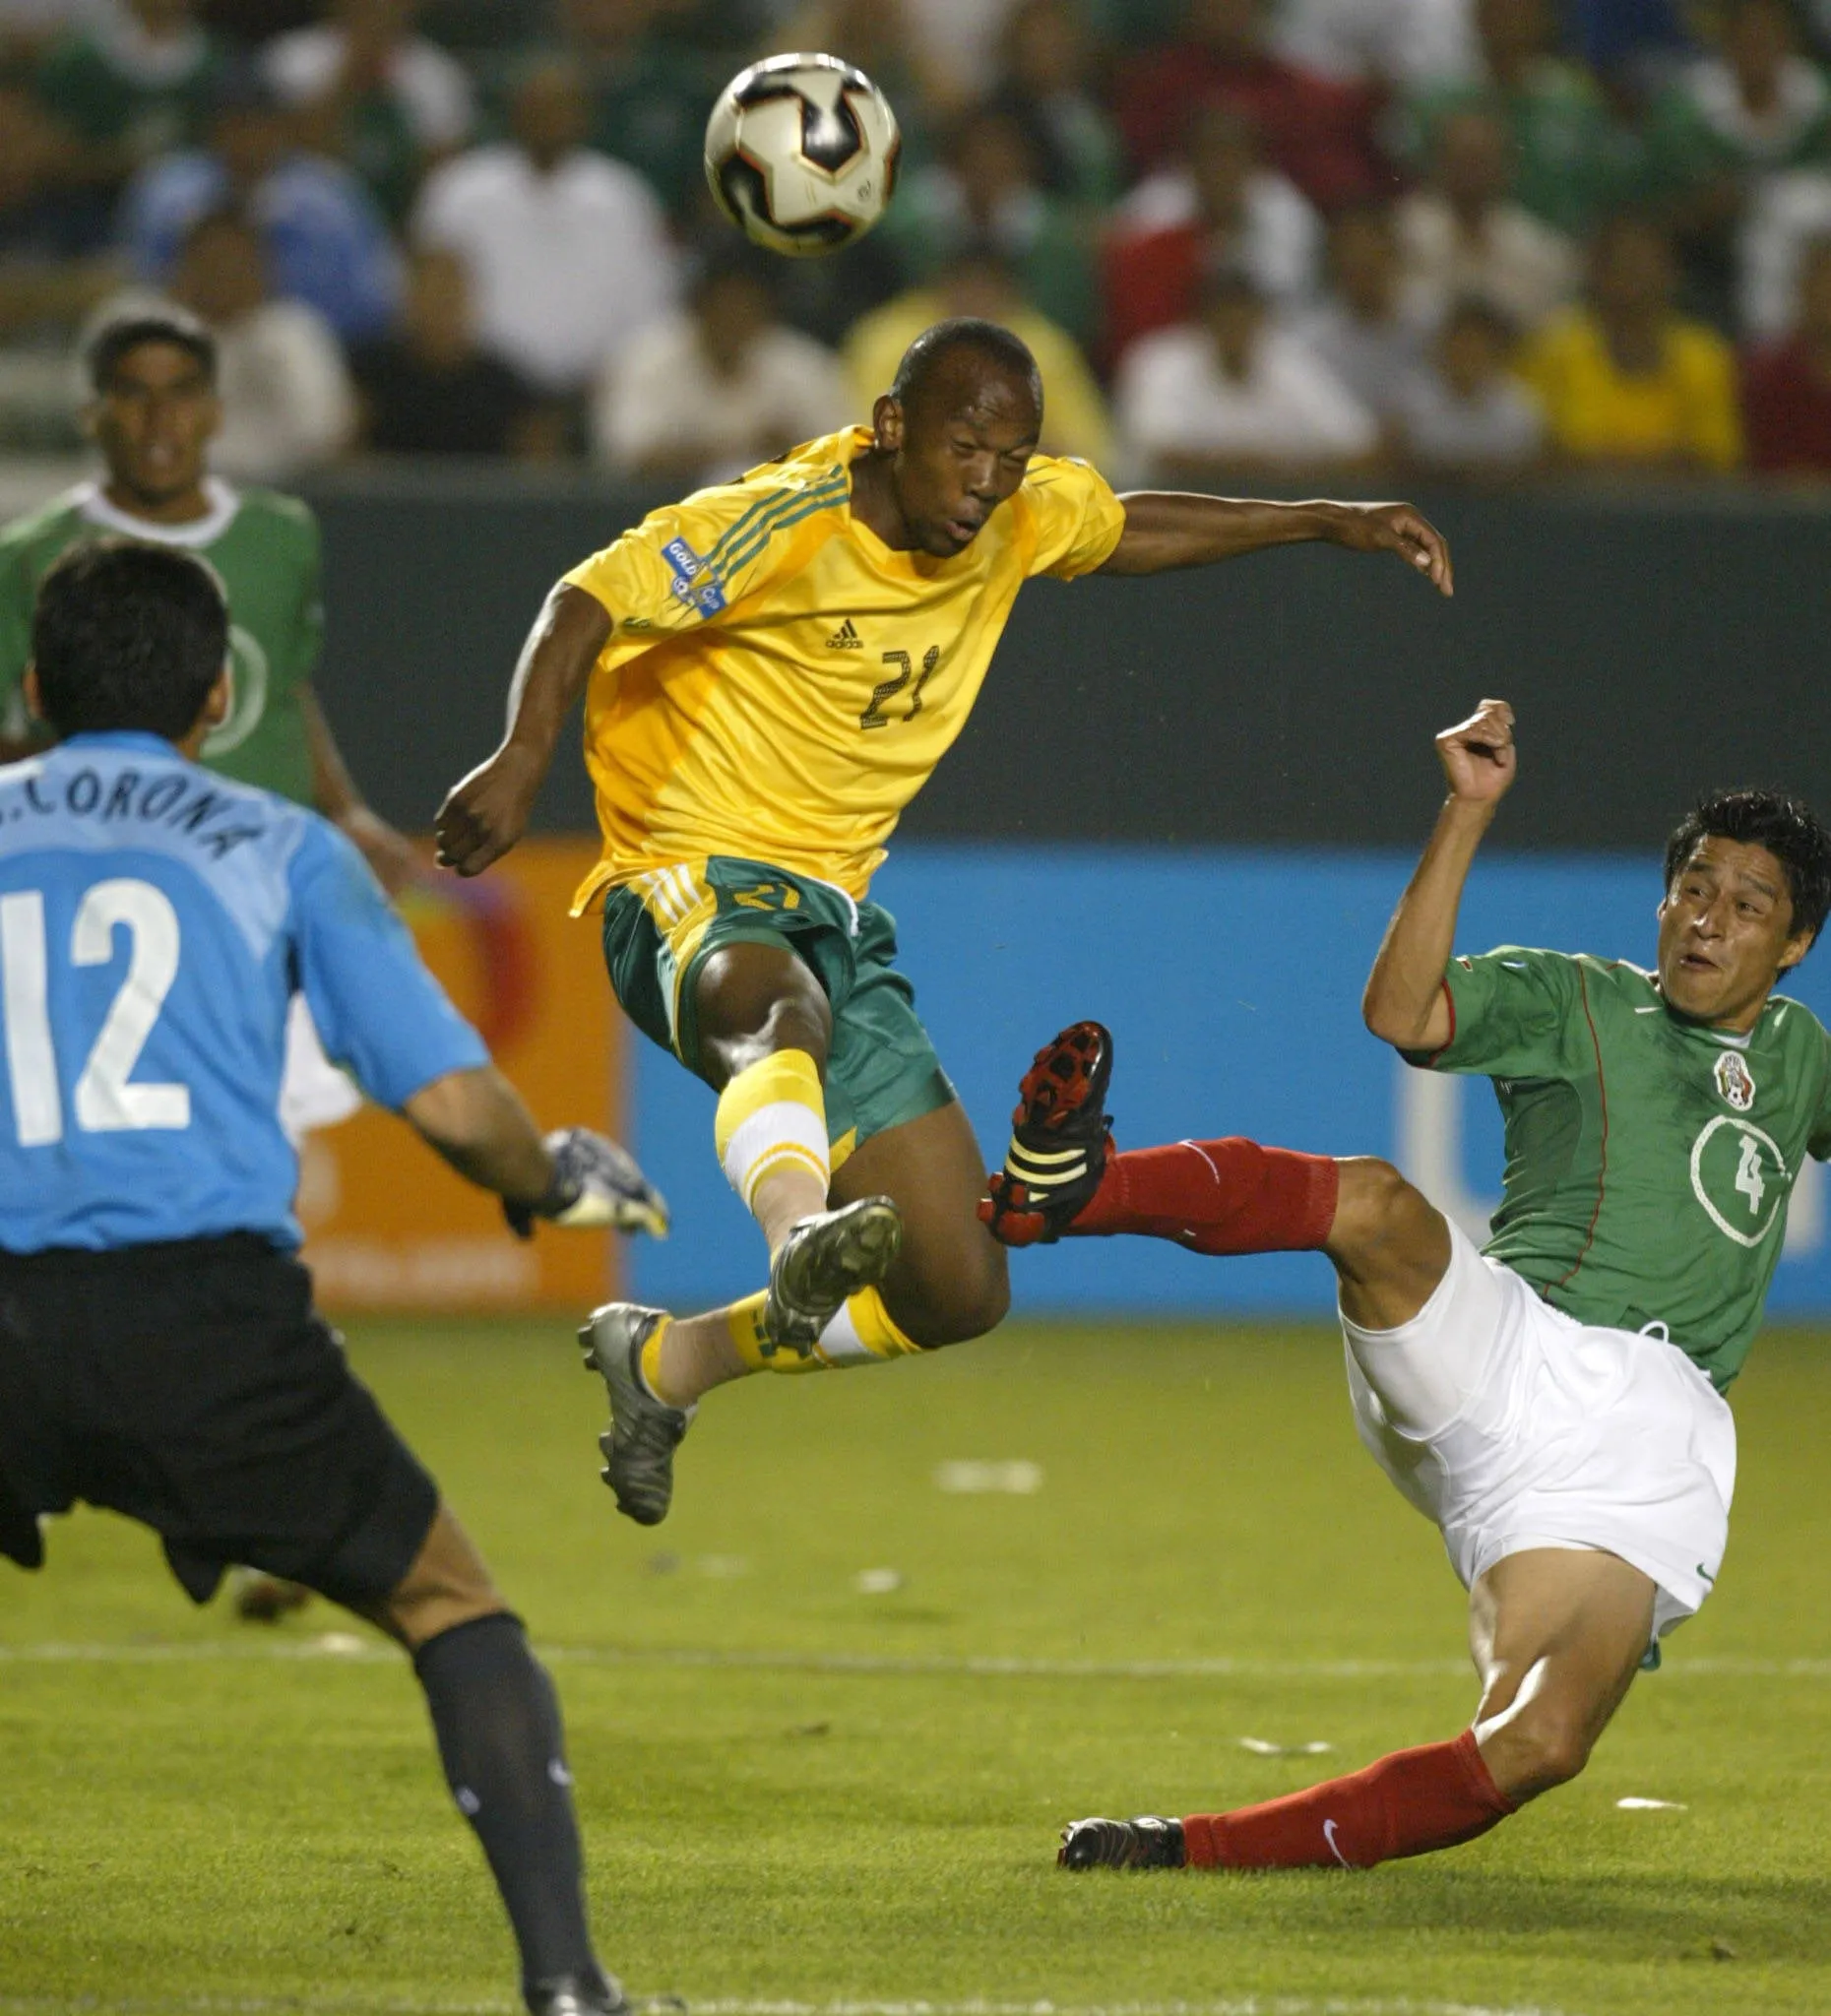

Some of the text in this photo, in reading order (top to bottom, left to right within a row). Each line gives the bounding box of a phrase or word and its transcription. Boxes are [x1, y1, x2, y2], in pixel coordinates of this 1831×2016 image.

[669, 542, 697, 576] GOLD
[825, 638, 864, 650] adidas
[859, 645, 940, 730] 21
[1, 877, 191, 1147] 12
[1735, 1134, 1766, 1217] 4
